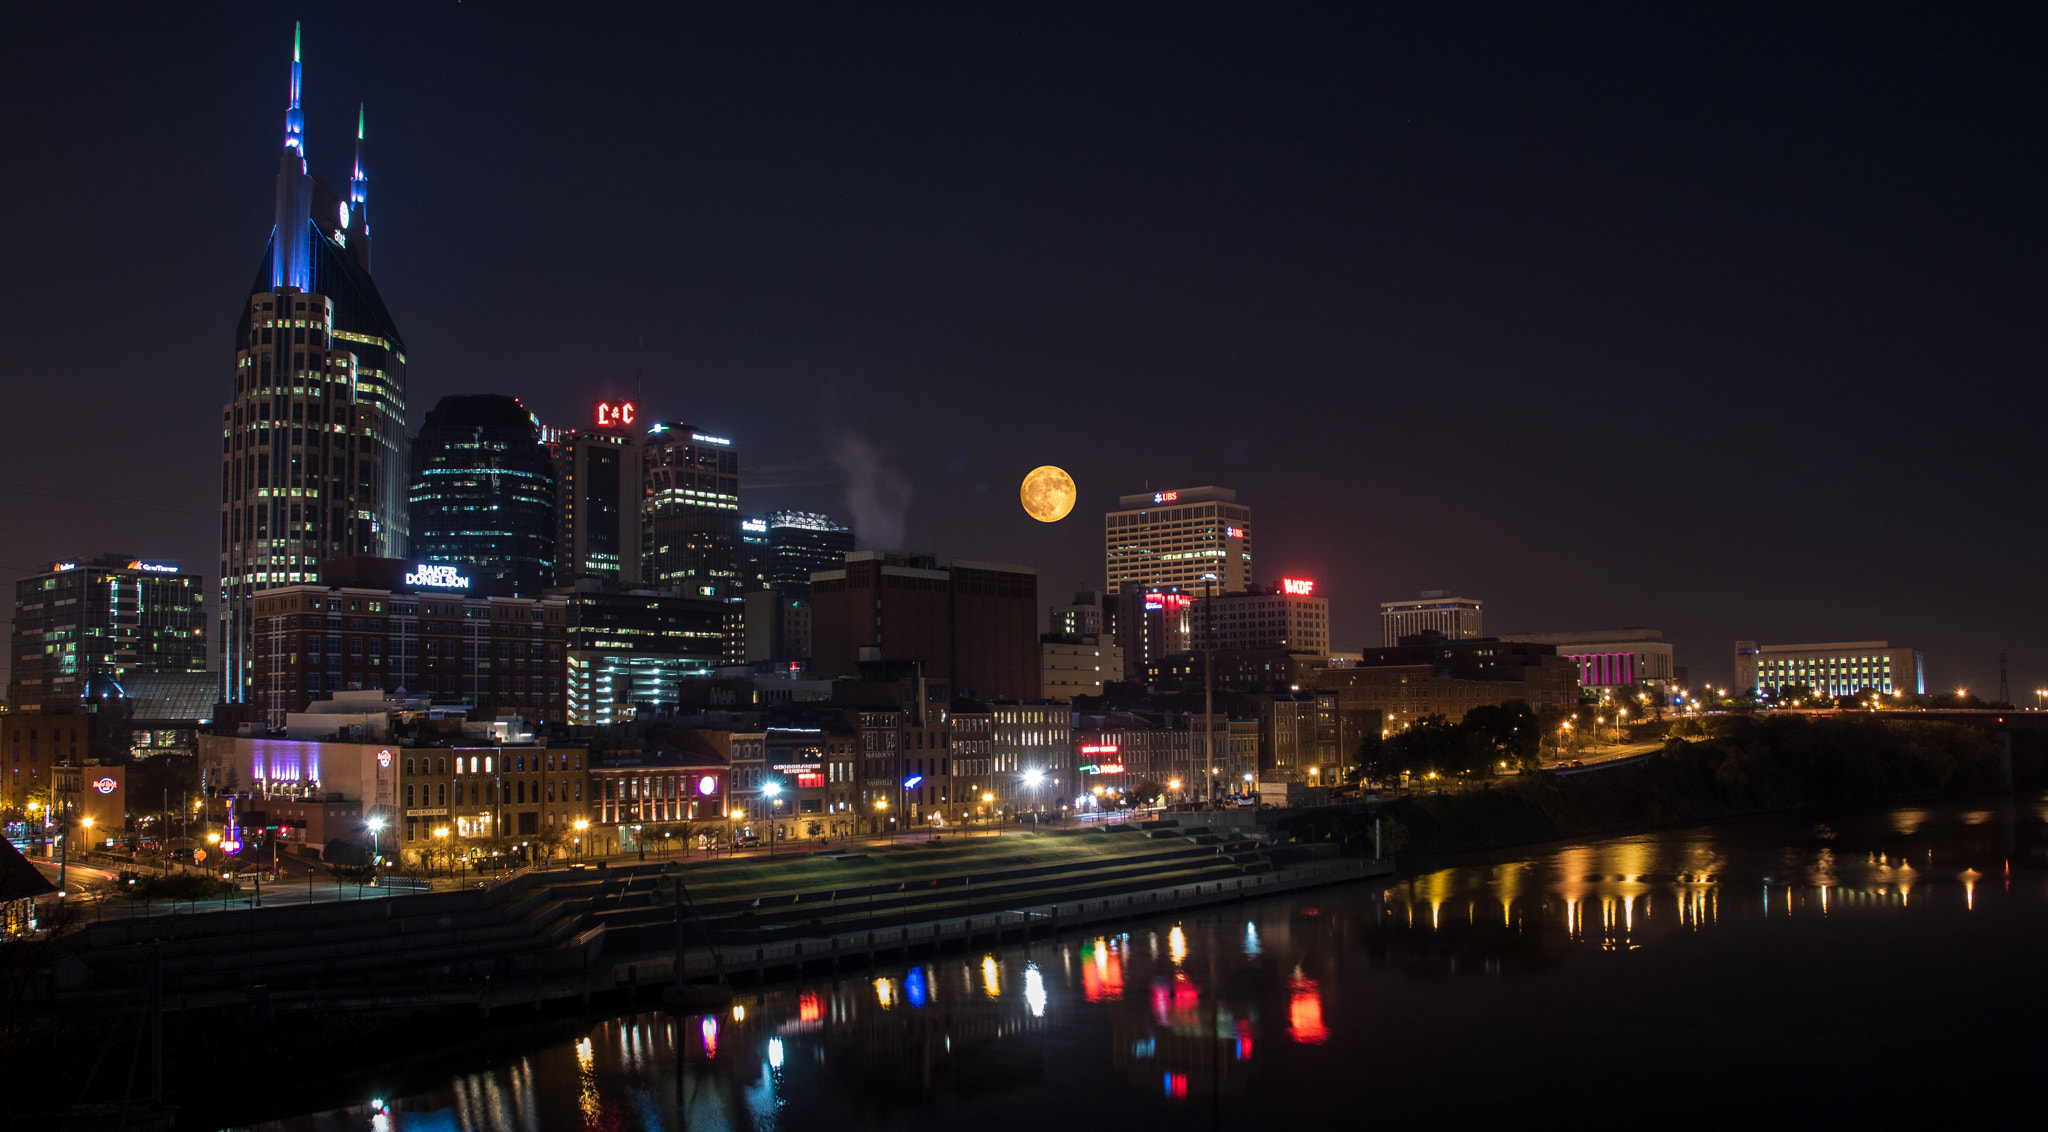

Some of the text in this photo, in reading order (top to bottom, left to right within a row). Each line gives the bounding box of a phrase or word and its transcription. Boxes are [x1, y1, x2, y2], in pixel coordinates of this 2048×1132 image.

[1162, 491, 1177, 502] UBS
[1232, 528, 1244, 538] UBS
[417, 564, 458, 576] BAKER
[405, 573, 469, 588] DONELSON
[699, 586, 716, 596] CMT
[1284, 578, 1314, 595] WKDF
